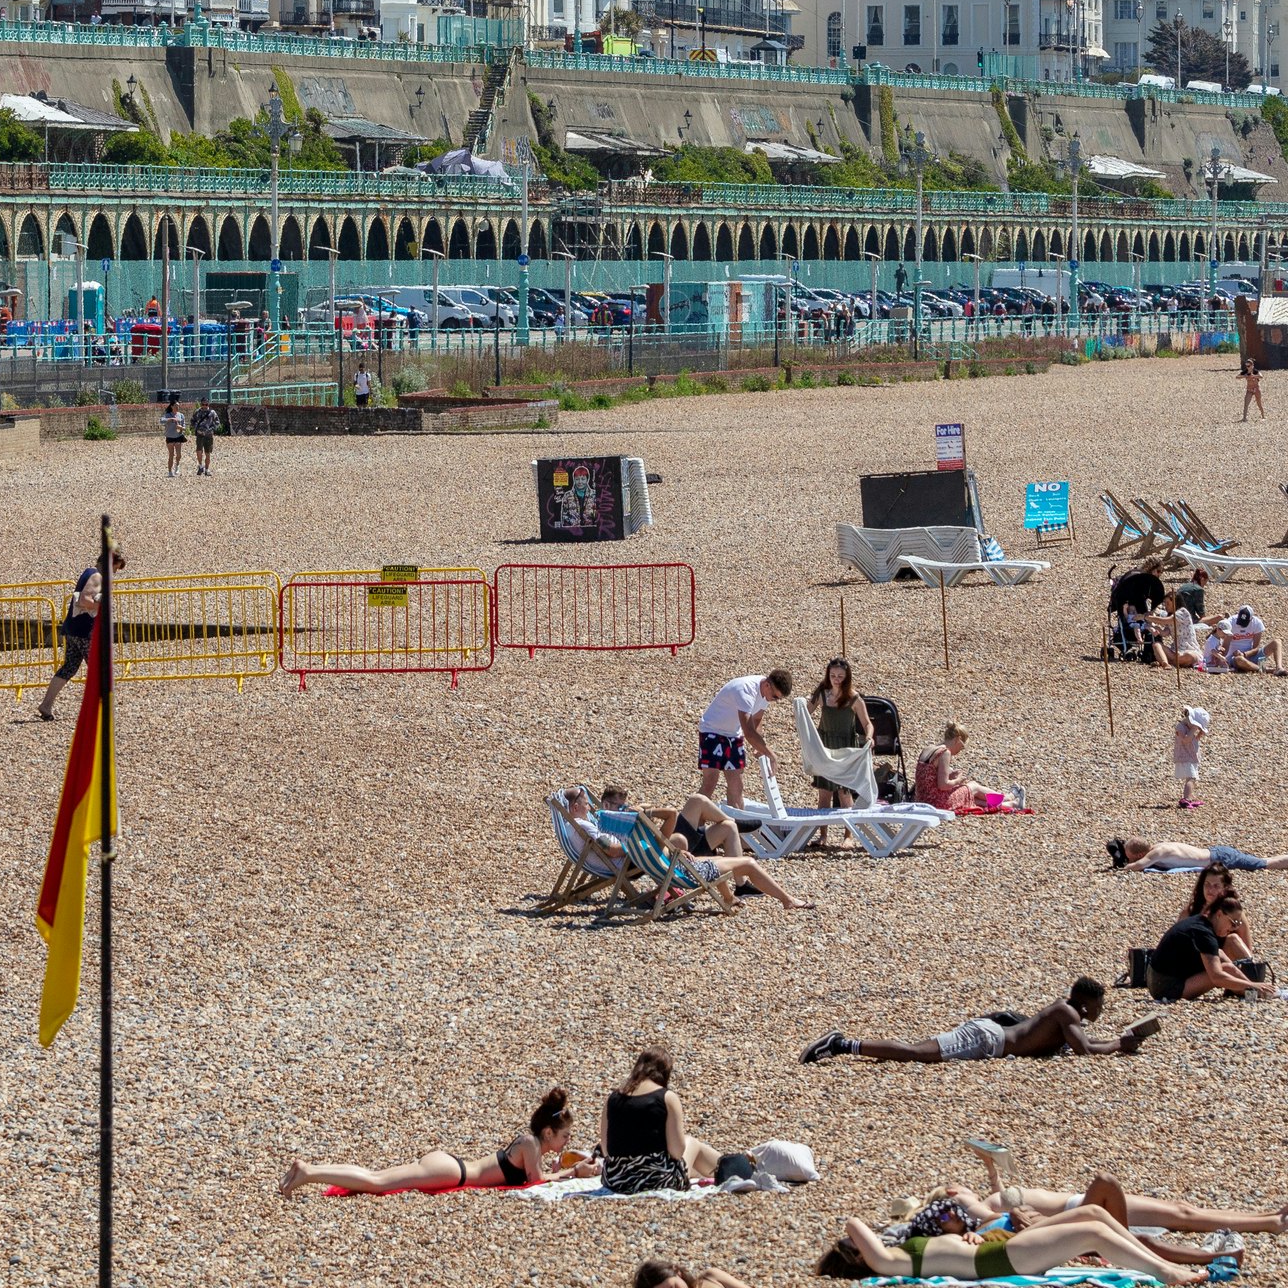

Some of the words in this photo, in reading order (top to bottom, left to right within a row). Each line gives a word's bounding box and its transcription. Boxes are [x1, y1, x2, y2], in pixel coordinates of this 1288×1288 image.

[937, 426, 947, 436] For
[947, 425, 961, 436] Hire
[1034, 482, 1061, 493] NO
